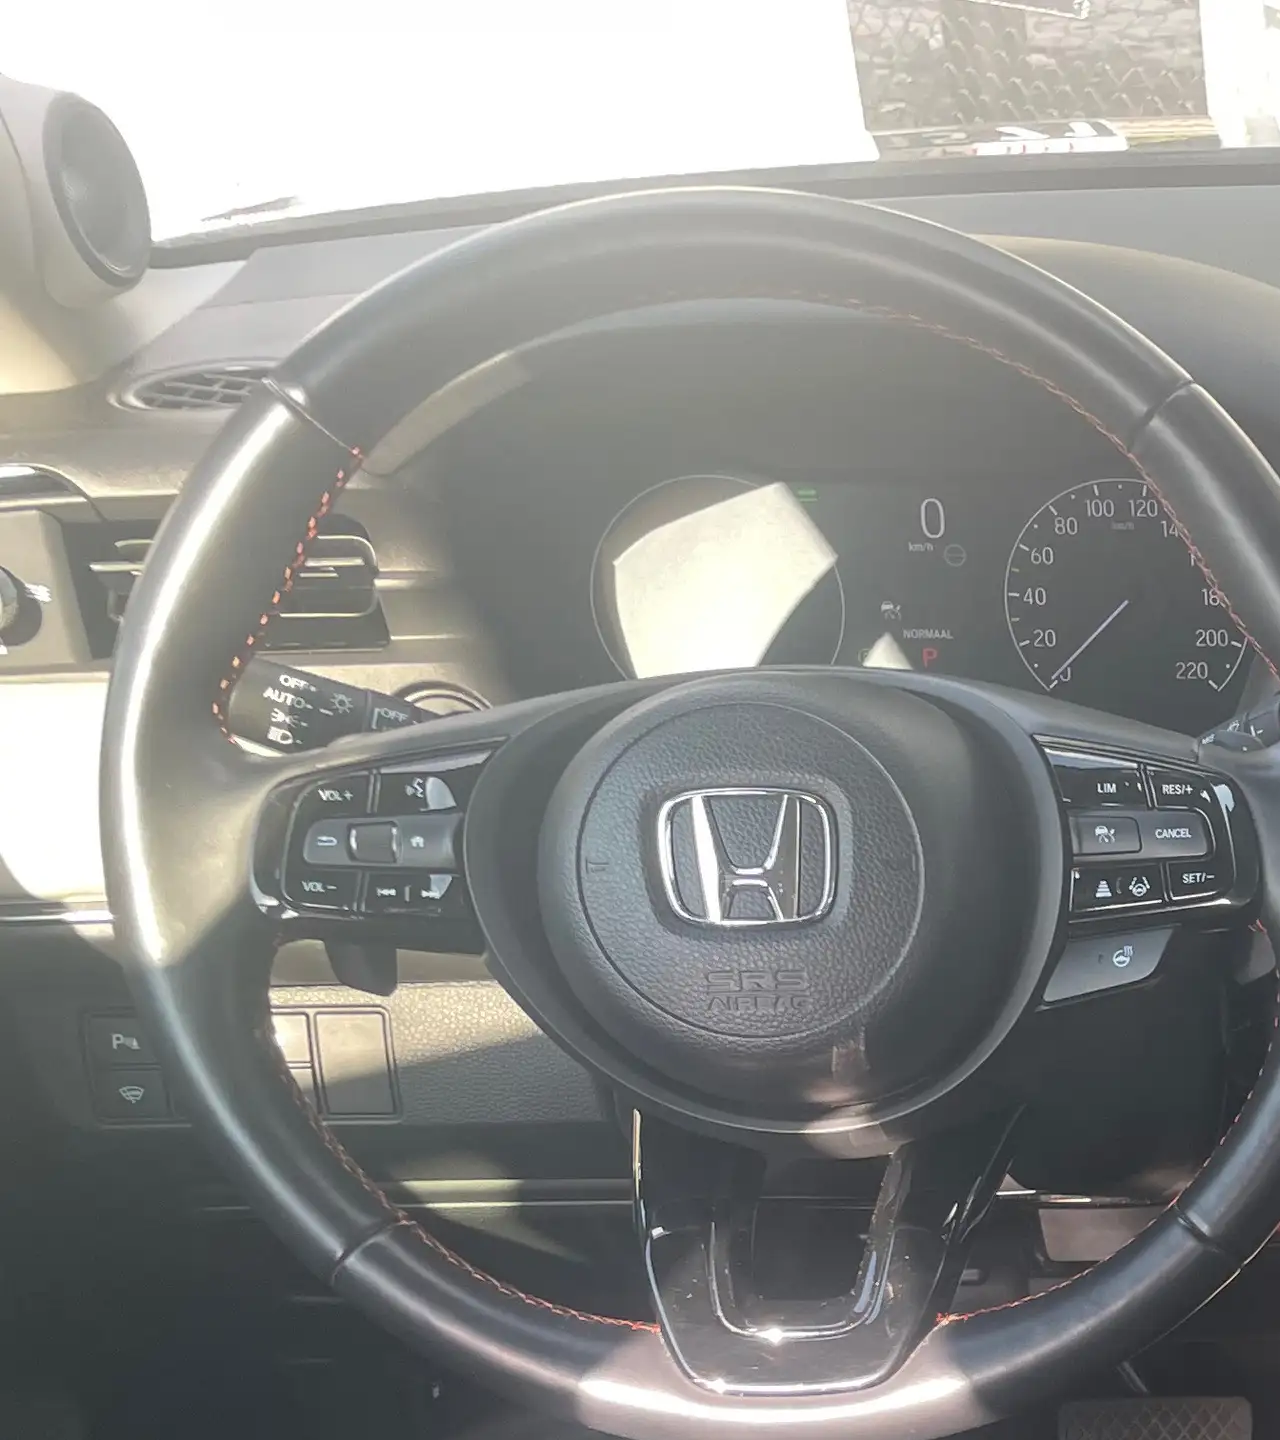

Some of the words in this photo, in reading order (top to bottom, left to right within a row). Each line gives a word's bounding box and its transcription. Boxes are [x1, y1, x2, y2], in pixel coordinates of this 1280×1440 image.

[1085, 499, 1115, 518] 100
[1129, 499, 1158, 518] 120
[920, 498, 945, 539] 0
[1054, 517, 1078, 536] 80
[1161, 520, 1182, 538] 14
[908, 542, 934, 552] km/h
[1031, 546, 1054, 565] 60
[1023, 587, 1047, 606] 40
[1201, 588, 1224, 607] 18
[903, 629, 953, 639] NORMAAL
[1033, 629, 1056, 648] 20
[1195, 629, 1228, 648] 200
[922, 647, 938, 668] P
[1175, 661, 1208, 680] 220
[279, 674, 309, 690] OFF
[263, 686, 305, 708] AUTO
[1097, 782, 1116, 794] LIM
[1155, 828, 1192, 839] CANCEL
